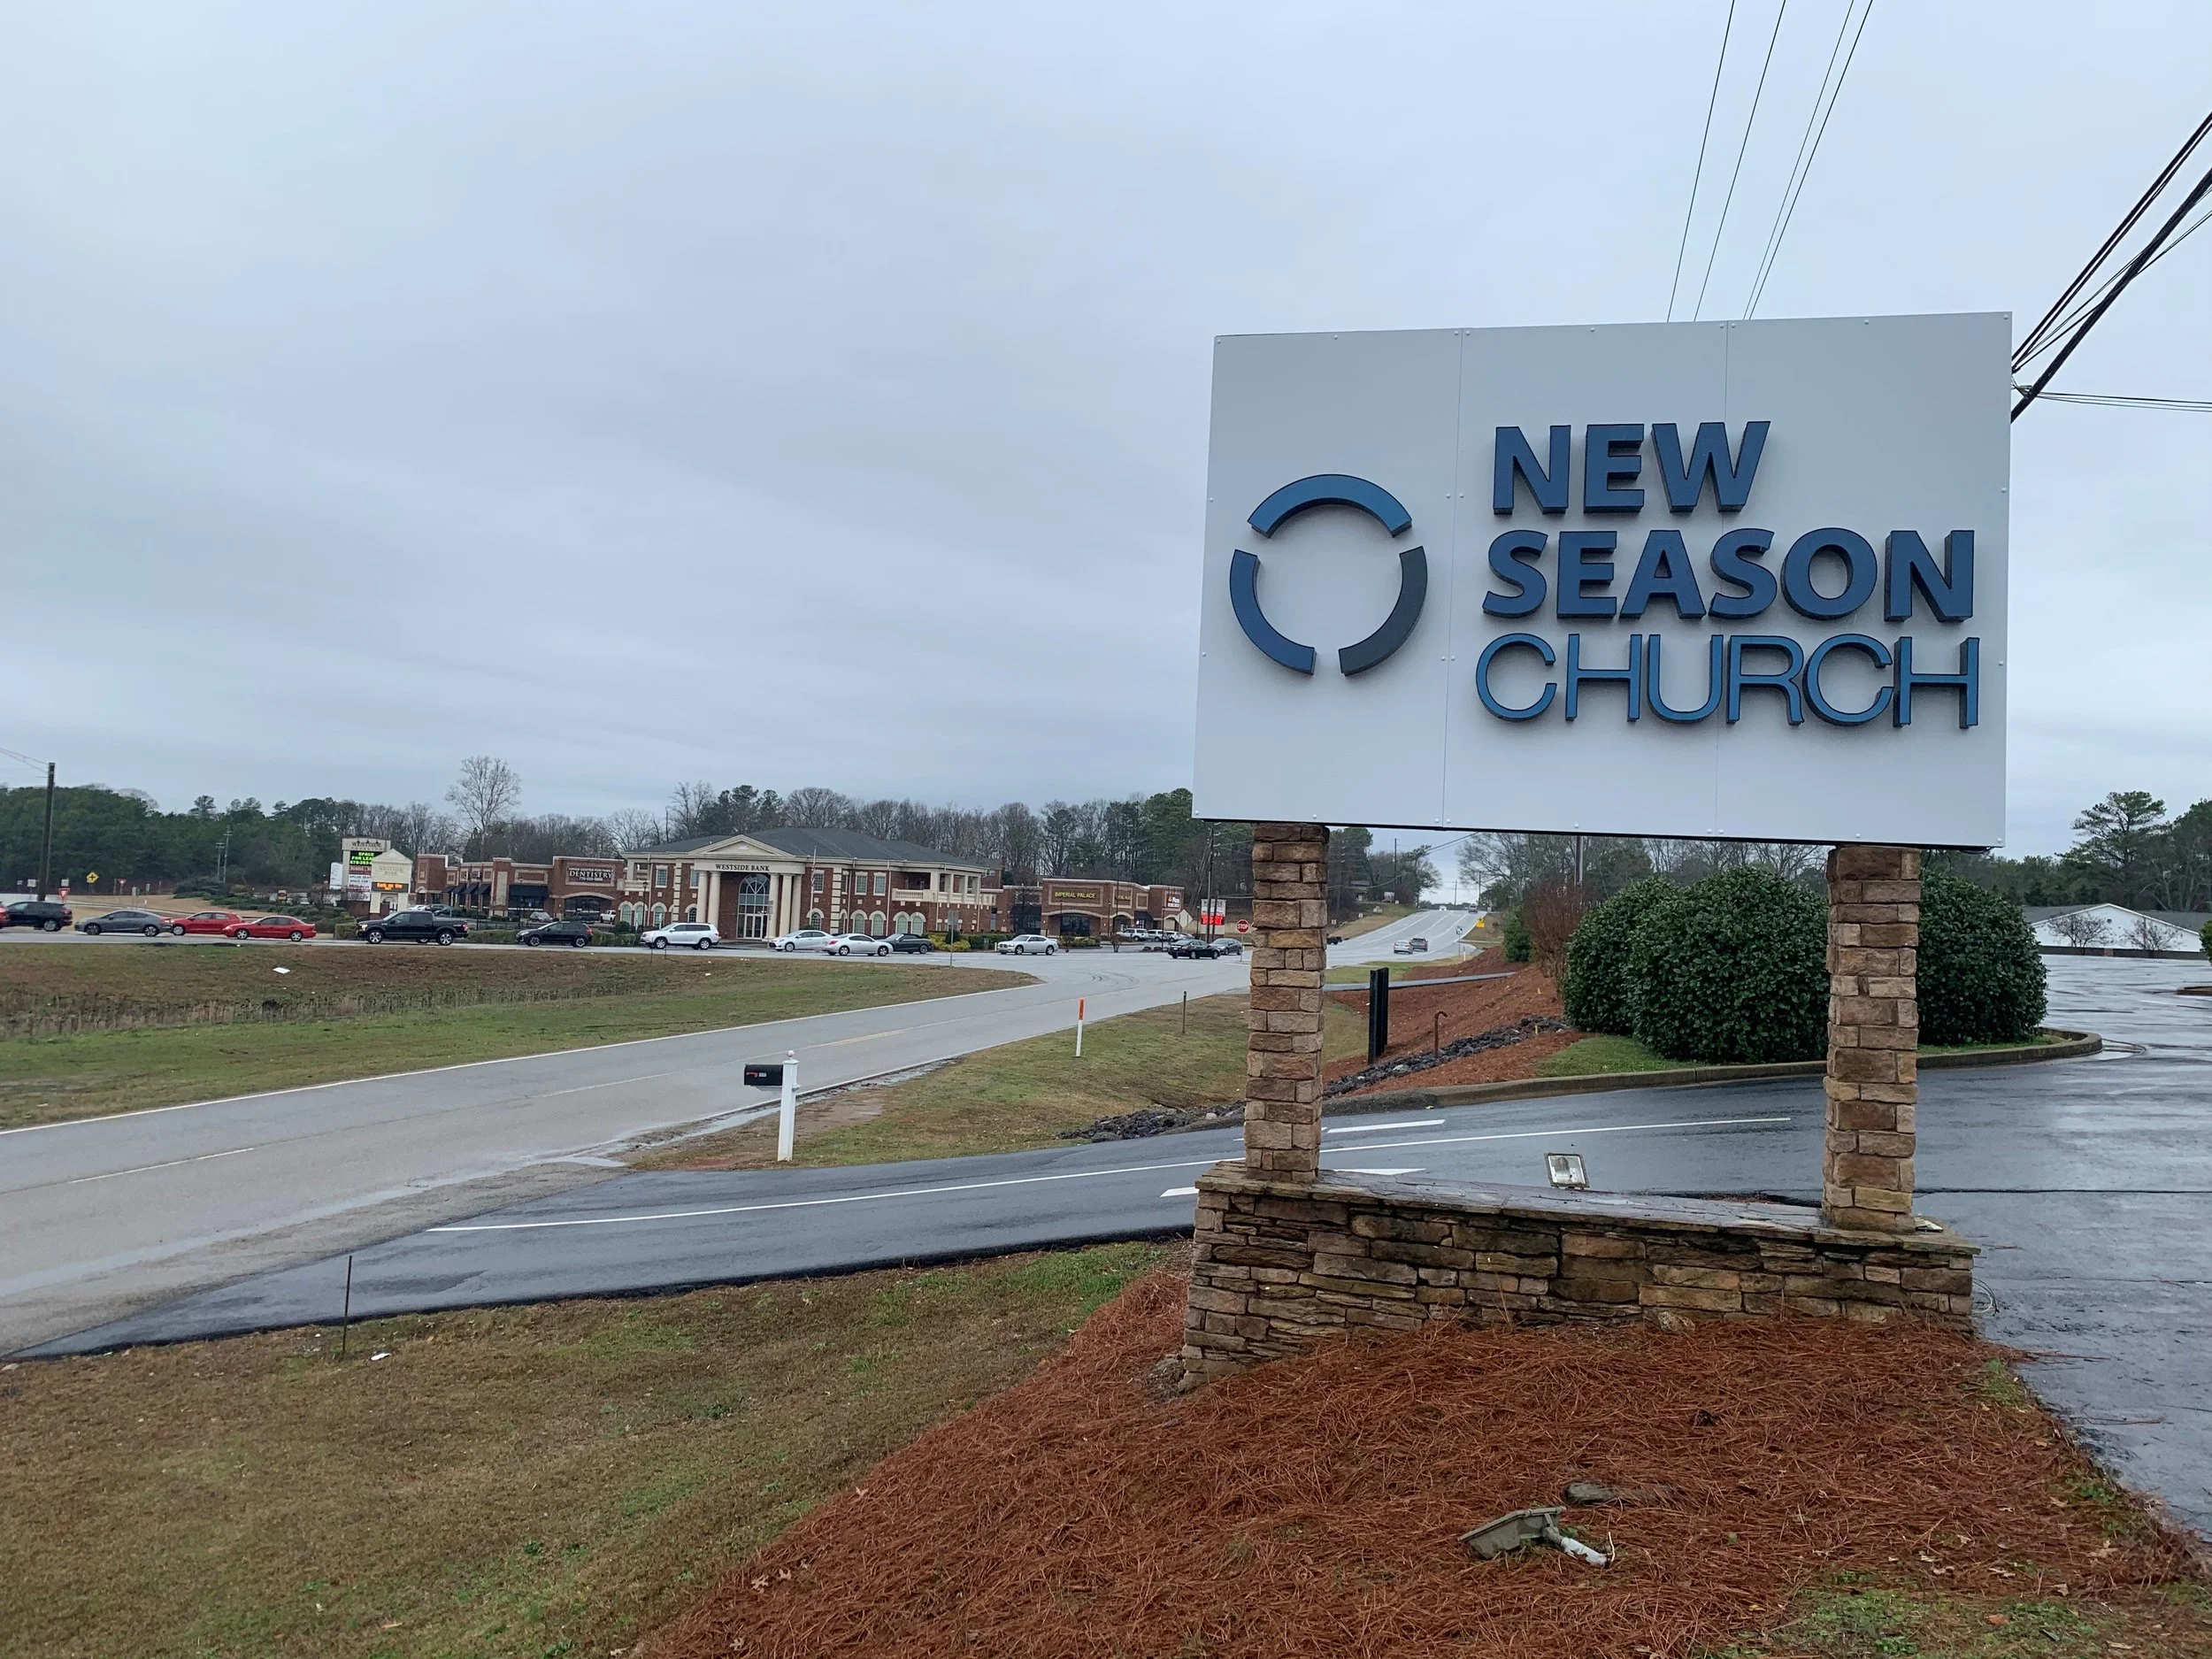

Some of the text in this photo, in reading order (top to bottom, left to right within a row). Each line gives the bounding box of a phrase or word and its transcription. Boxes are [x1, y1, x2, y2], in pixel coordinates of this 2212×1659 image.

[1493, 420, 1770, 515] NEW
[1482, 527, 1975, 622] SEASON
[1476, 633, 1980, 728] CHURCH
